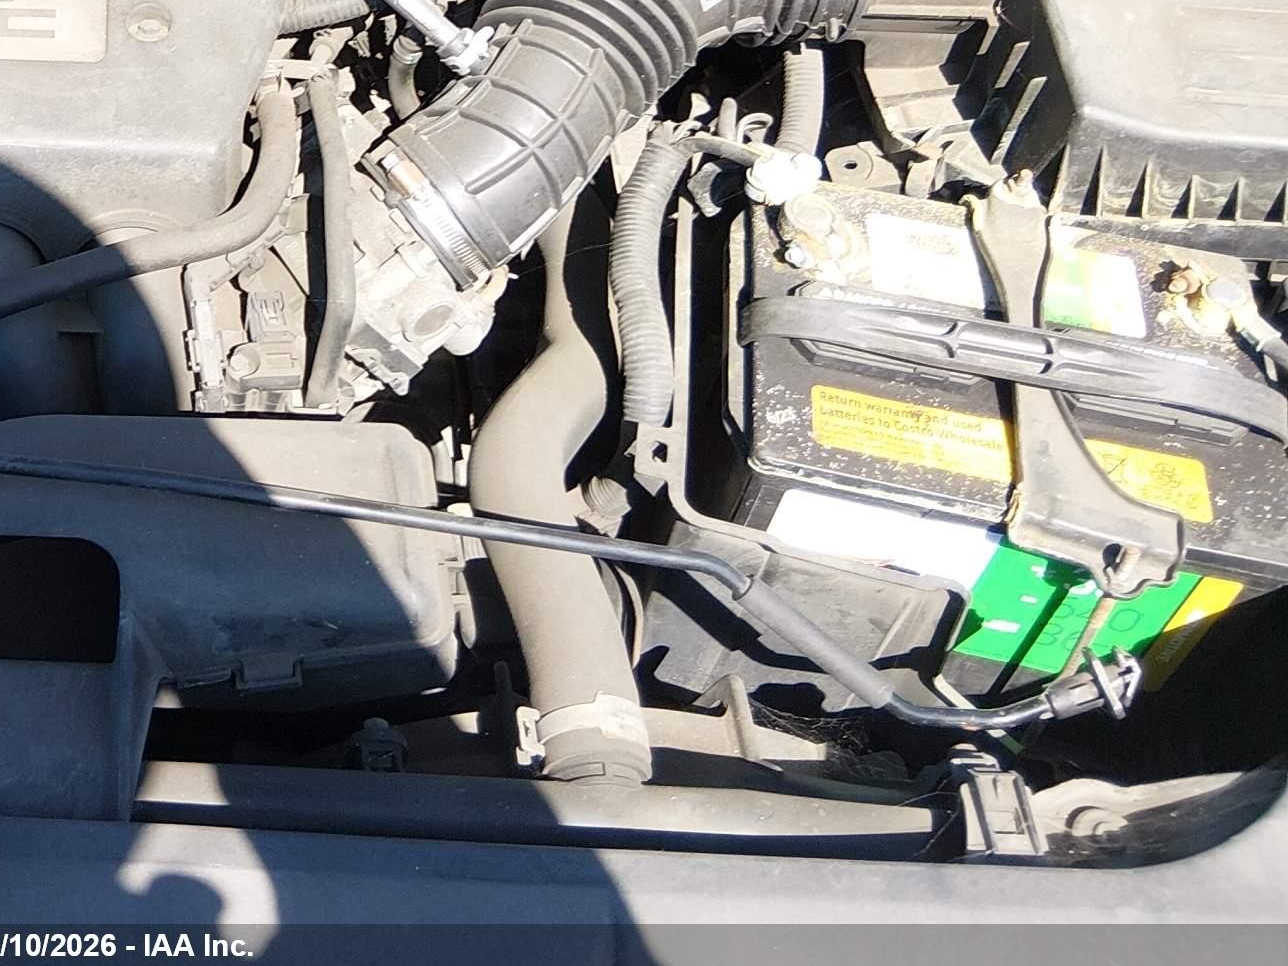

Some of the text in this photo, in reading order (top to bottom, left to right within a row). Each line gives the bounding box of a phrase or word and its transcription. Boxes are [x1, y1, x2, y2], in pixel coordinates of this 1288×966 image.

[819, 391, 862, 410] Return
[924, 411, 949, 426] and
[951, 418, 983, 433] used
[819, 406, 876, 427] batteries
[878, 418, 891, 430] to
[894, 419, 936, 437] Costco
[939, 429, 1004, 451] Wholesale
